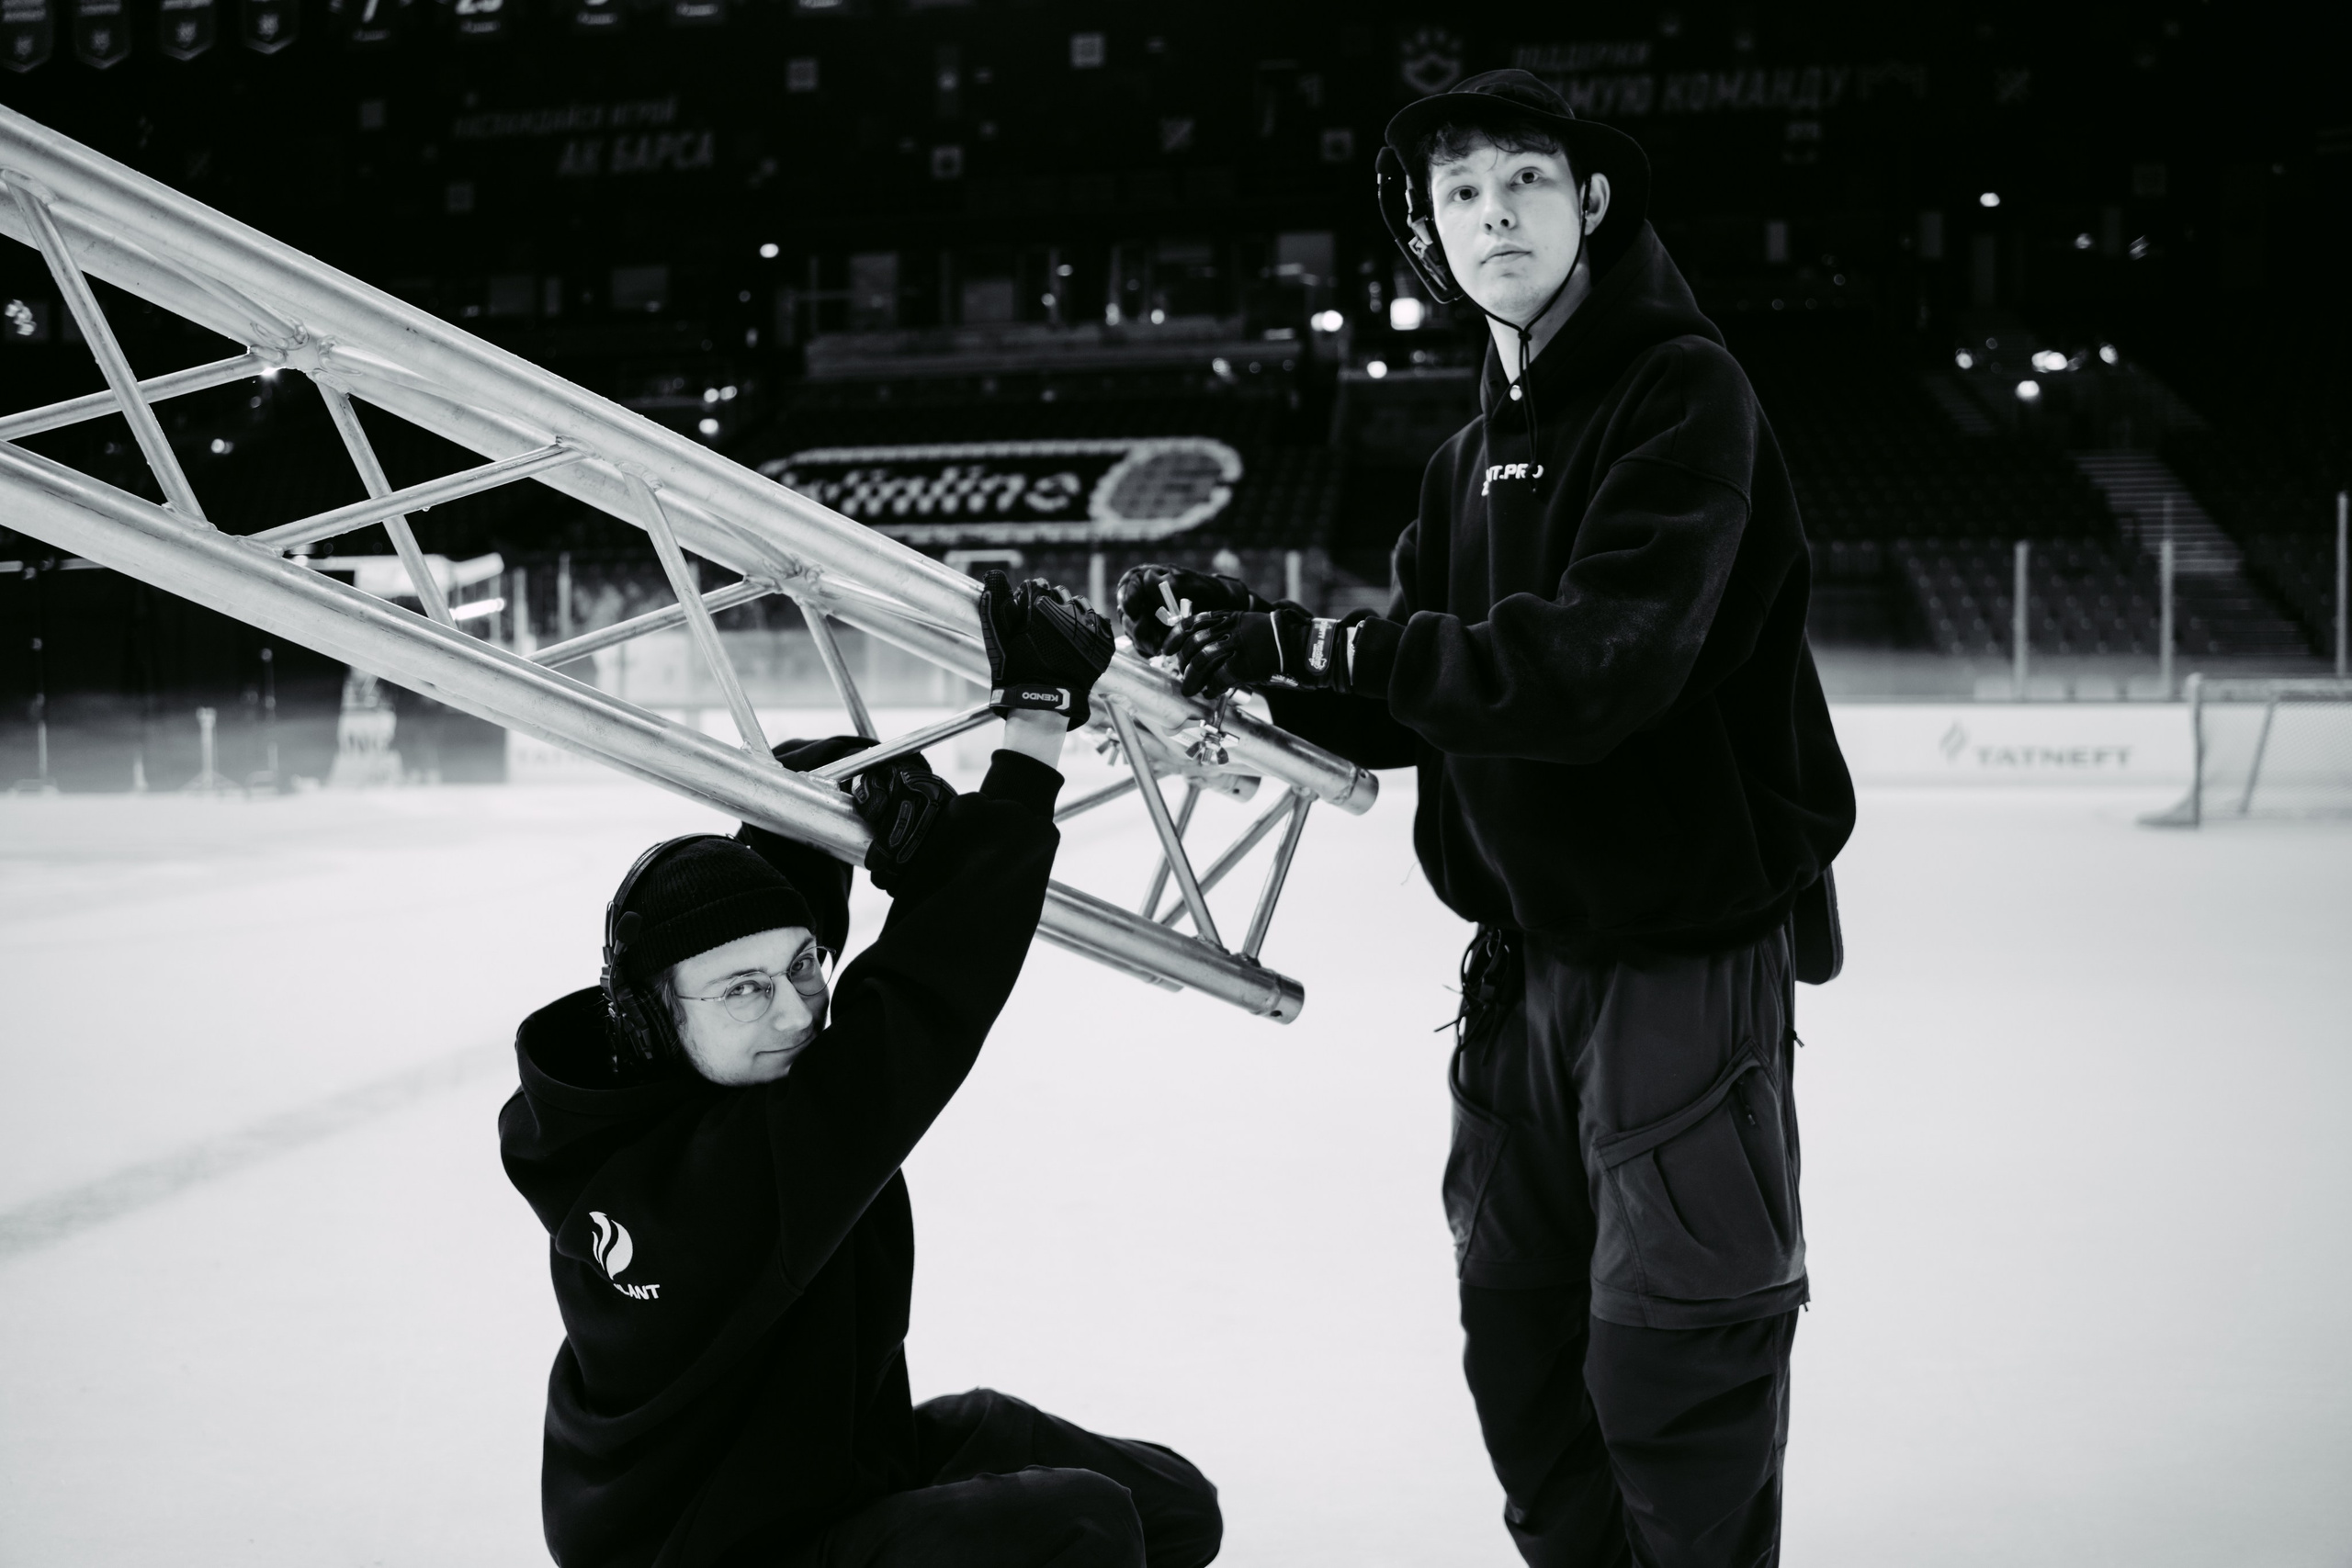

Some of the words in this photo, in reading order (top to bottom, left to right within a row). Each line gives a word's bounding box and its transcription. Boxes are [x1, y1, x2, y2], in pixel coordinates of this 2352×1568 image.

[1662, 65, 1849, 113] КОМАНДУ
[610, 130, 715, 174] БАРСА
[1022, 692, 1058, 702] KENDO
[1973, 745, 2132, 768] TATNEFT
